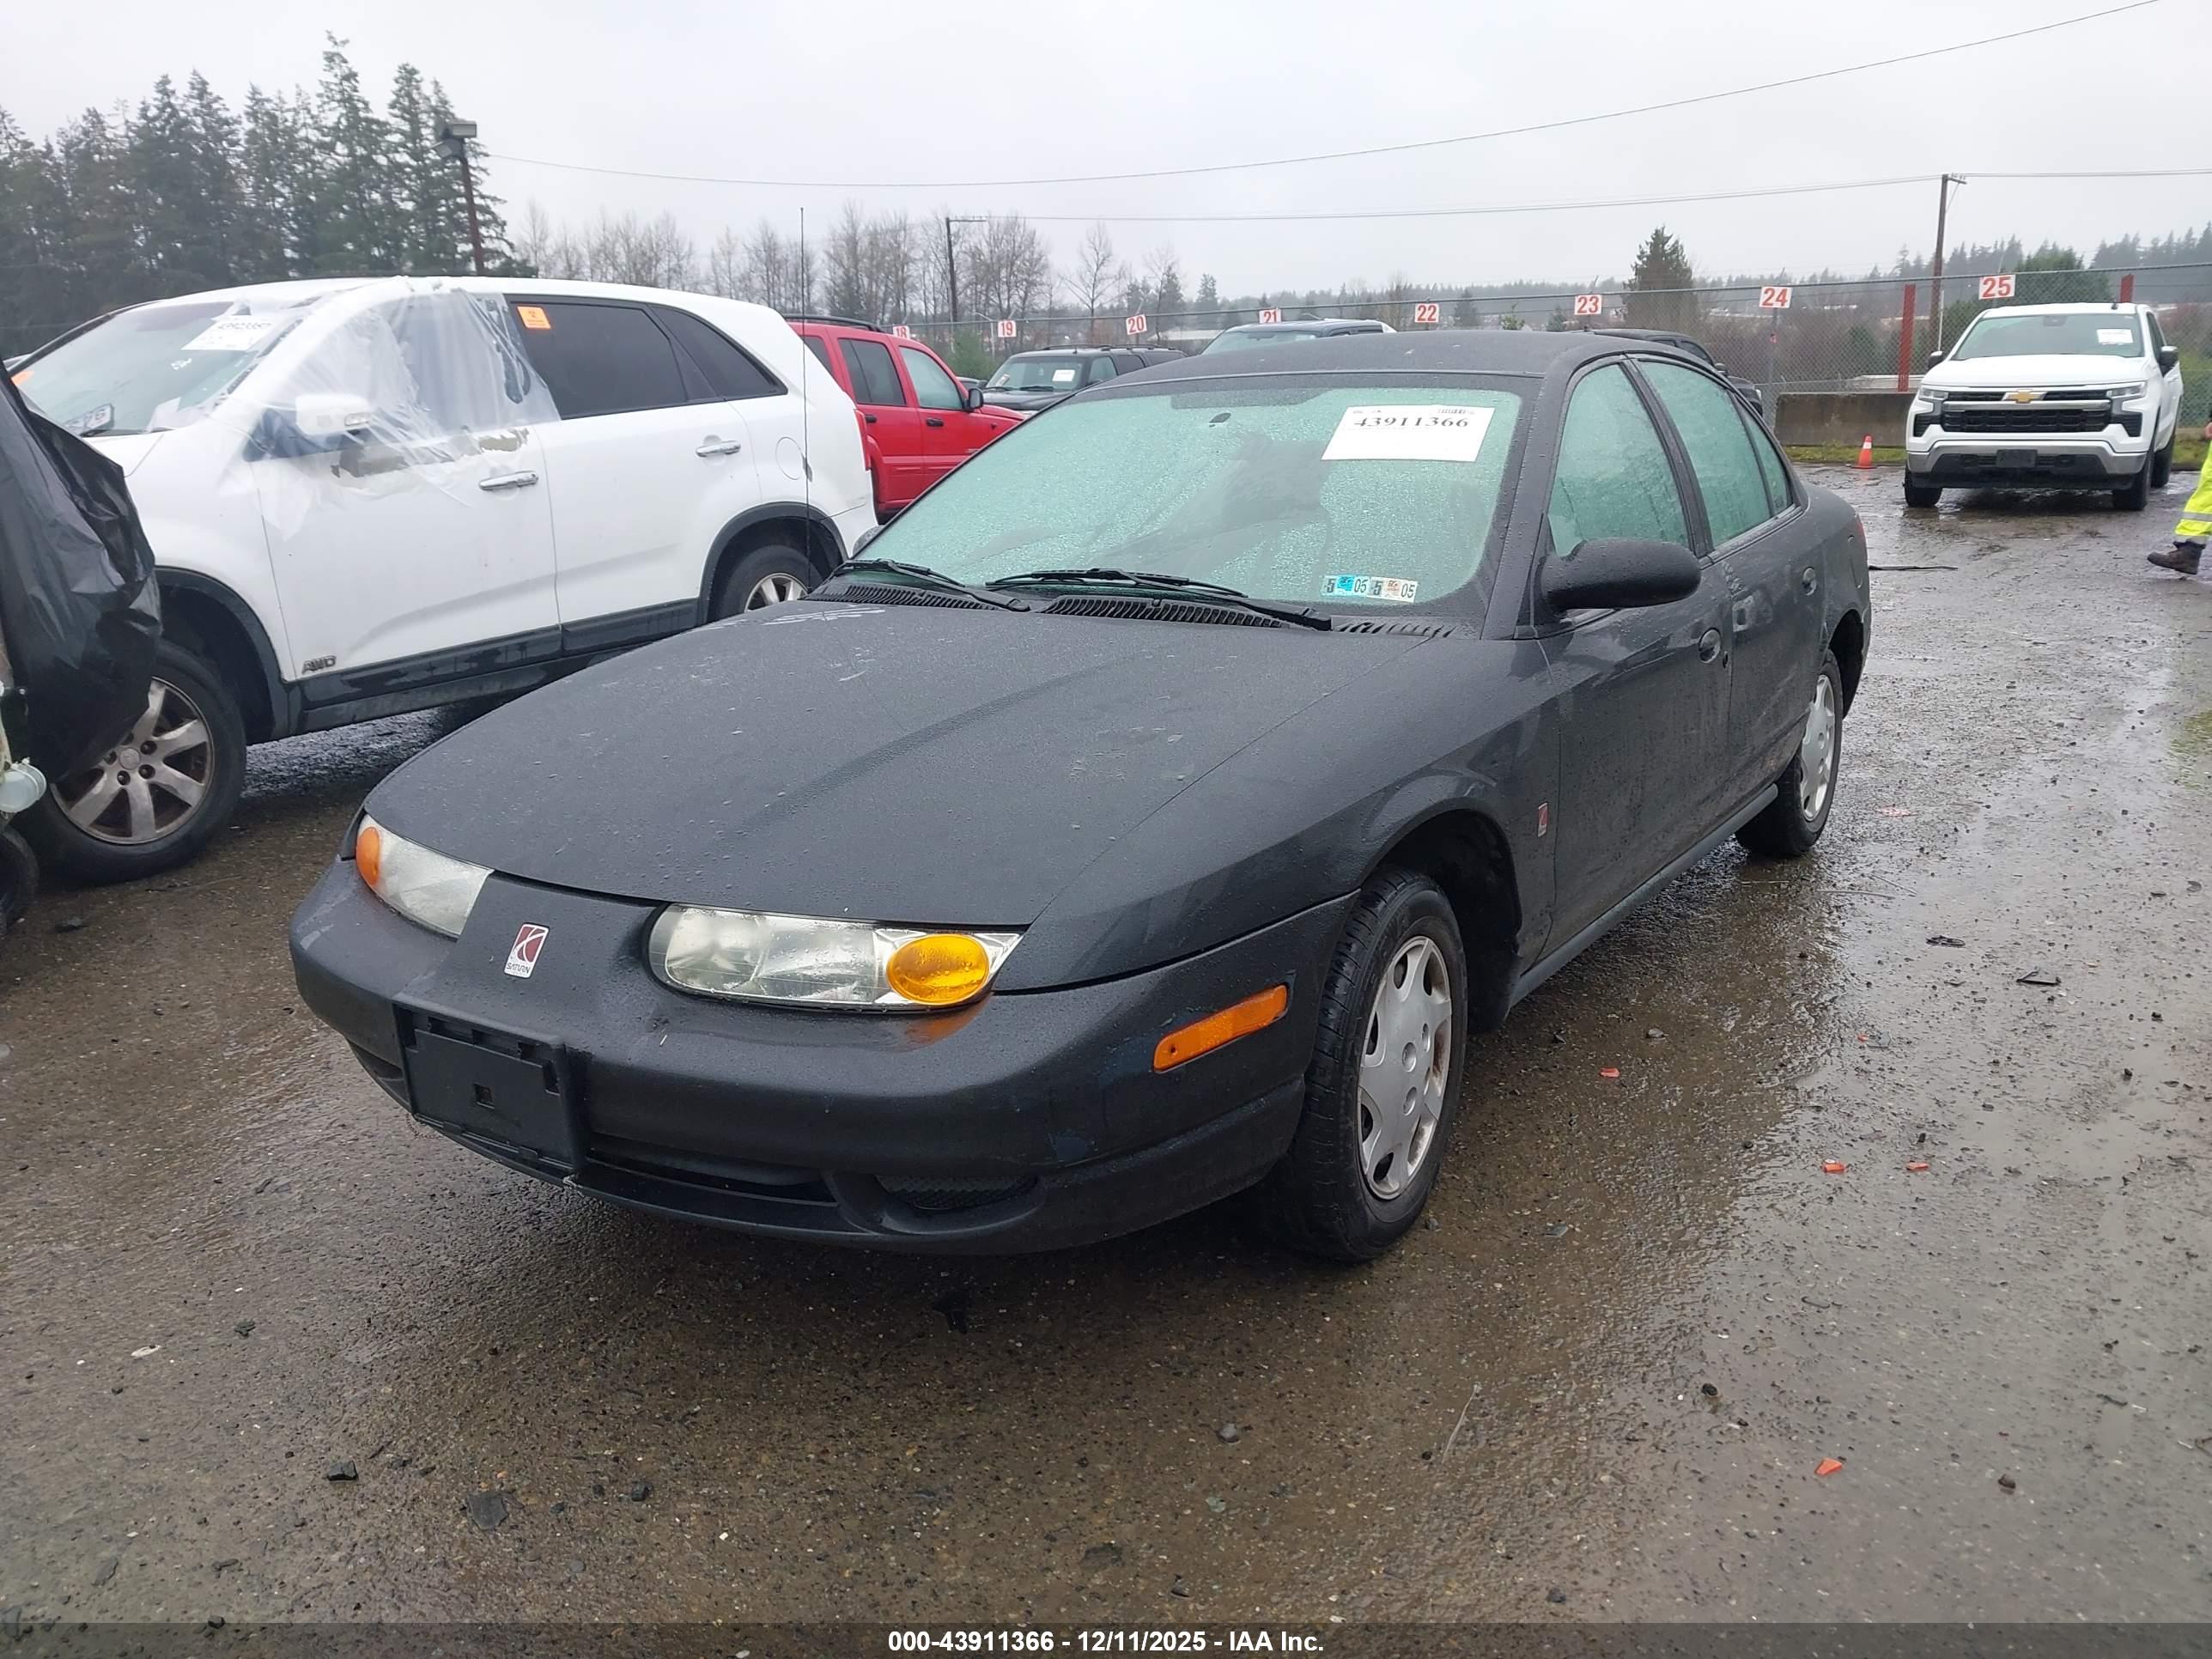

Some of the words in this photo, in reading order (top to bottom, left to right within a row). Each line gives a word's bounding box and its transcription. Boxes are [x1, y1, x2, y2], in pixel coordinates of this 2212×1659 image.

[1982, 276, 2012, 298] 25
[1577, 295, 1600, 313] 23
[1761, 288, 1789, 307] 24
[1264, 310, 1277, 324] 21
[1417, 304, 1437, 322] 22
[1001, 322, 1012, 336] 19
[1128, 317, 1146, 333] 20
[1353, 416, 1470, 428] 43911366
[1354, 578, 1369, 593] 05
[1401, 583, 1415, 598] 05
[301, 655, 337, 676] AWD
[507, 962, 531, 974] SATURN
